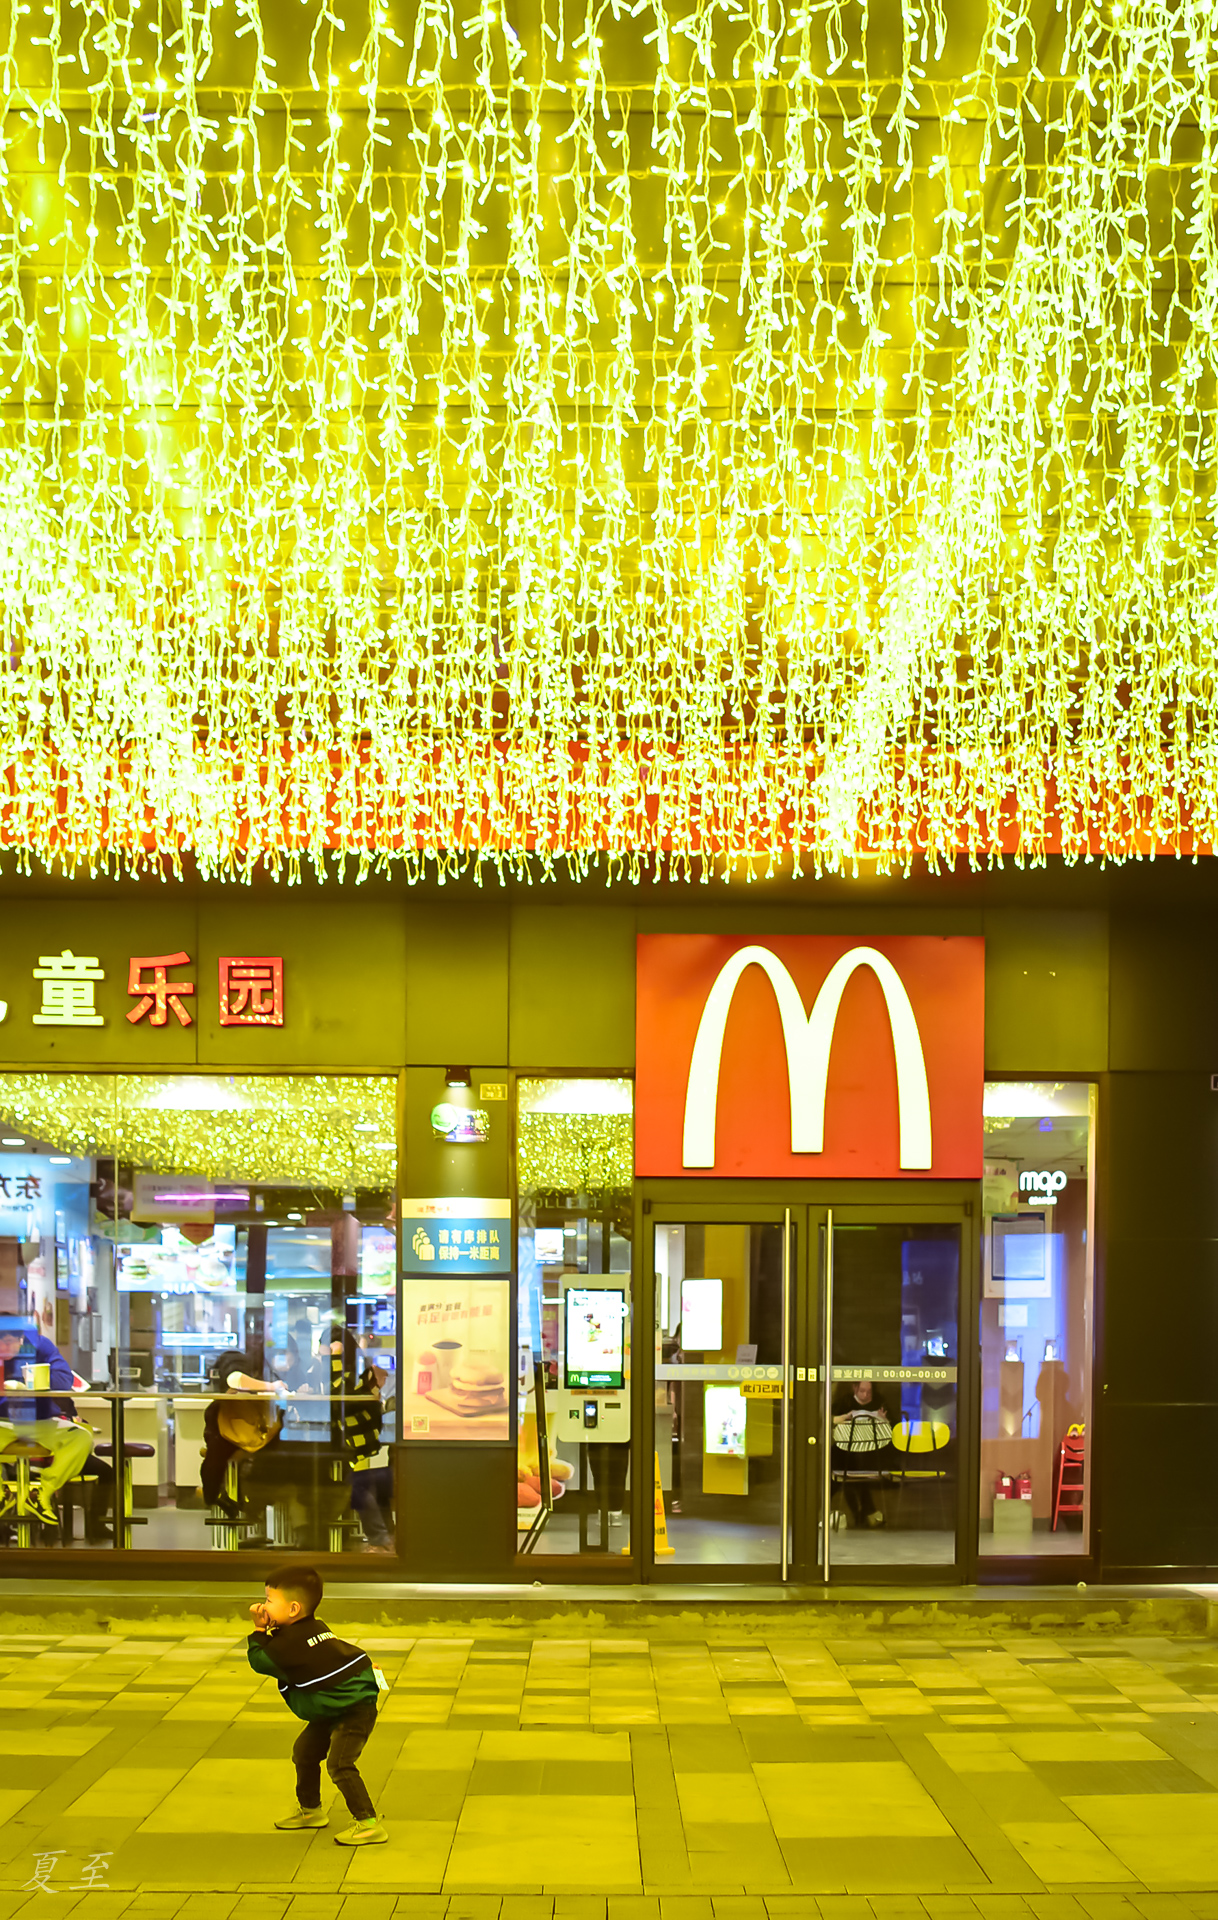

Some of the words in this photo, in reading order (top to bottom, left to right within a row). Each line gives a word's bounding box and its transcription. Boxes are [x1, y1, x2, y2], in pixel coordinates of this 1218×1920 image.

[0, 949, 284, 1027] 童乐园
[439, 1246, 500, 1261] 保持一米距离
